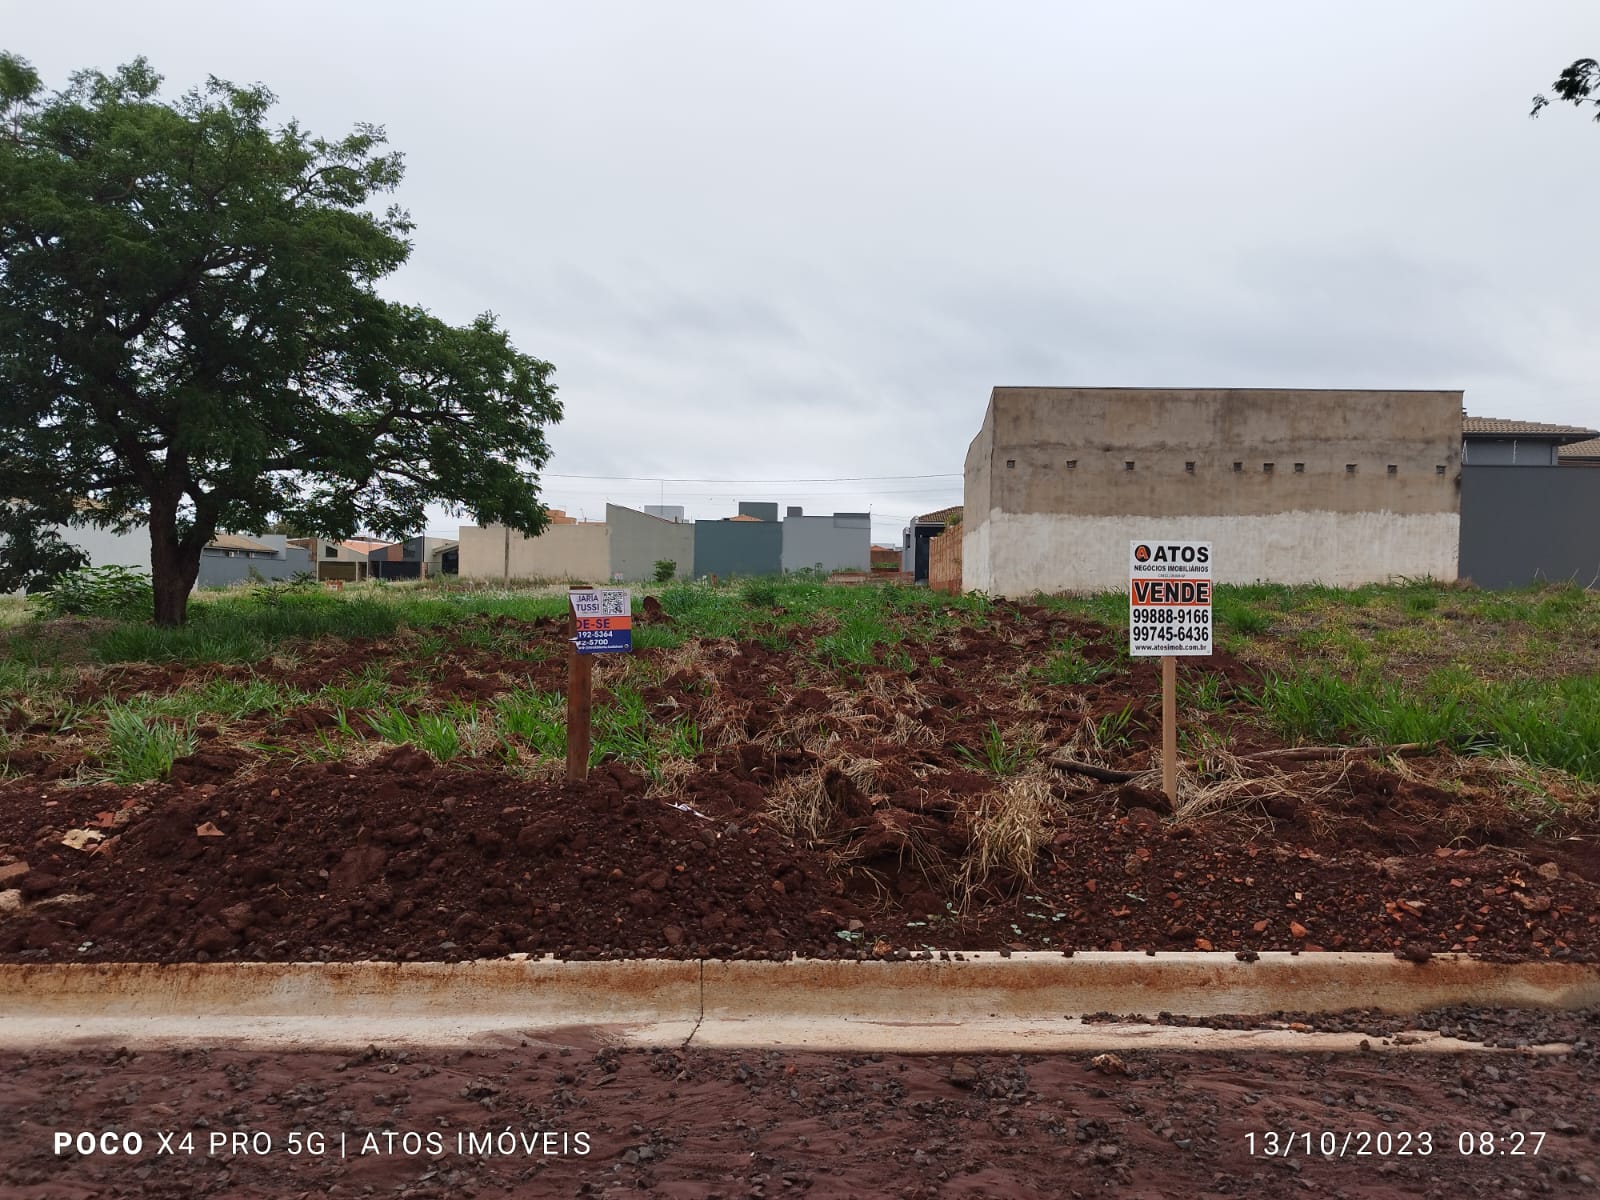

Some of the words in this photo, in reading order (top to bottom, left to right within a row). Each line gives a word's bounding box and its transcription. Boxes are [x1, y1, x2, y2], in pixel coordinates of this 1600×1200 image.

[1153, 546, 1209, 563] ATOS
[1134, 564, 1166, 572] NEGÓCIOS
[1168, 565, 1209, 573] IMOBILIÁRIOS
[1133, 581, 1209, 603] VENDE
[1133, 608, 1209, 624] 99888-9166
[1133, 626, 1209, 641] 99745-6436
